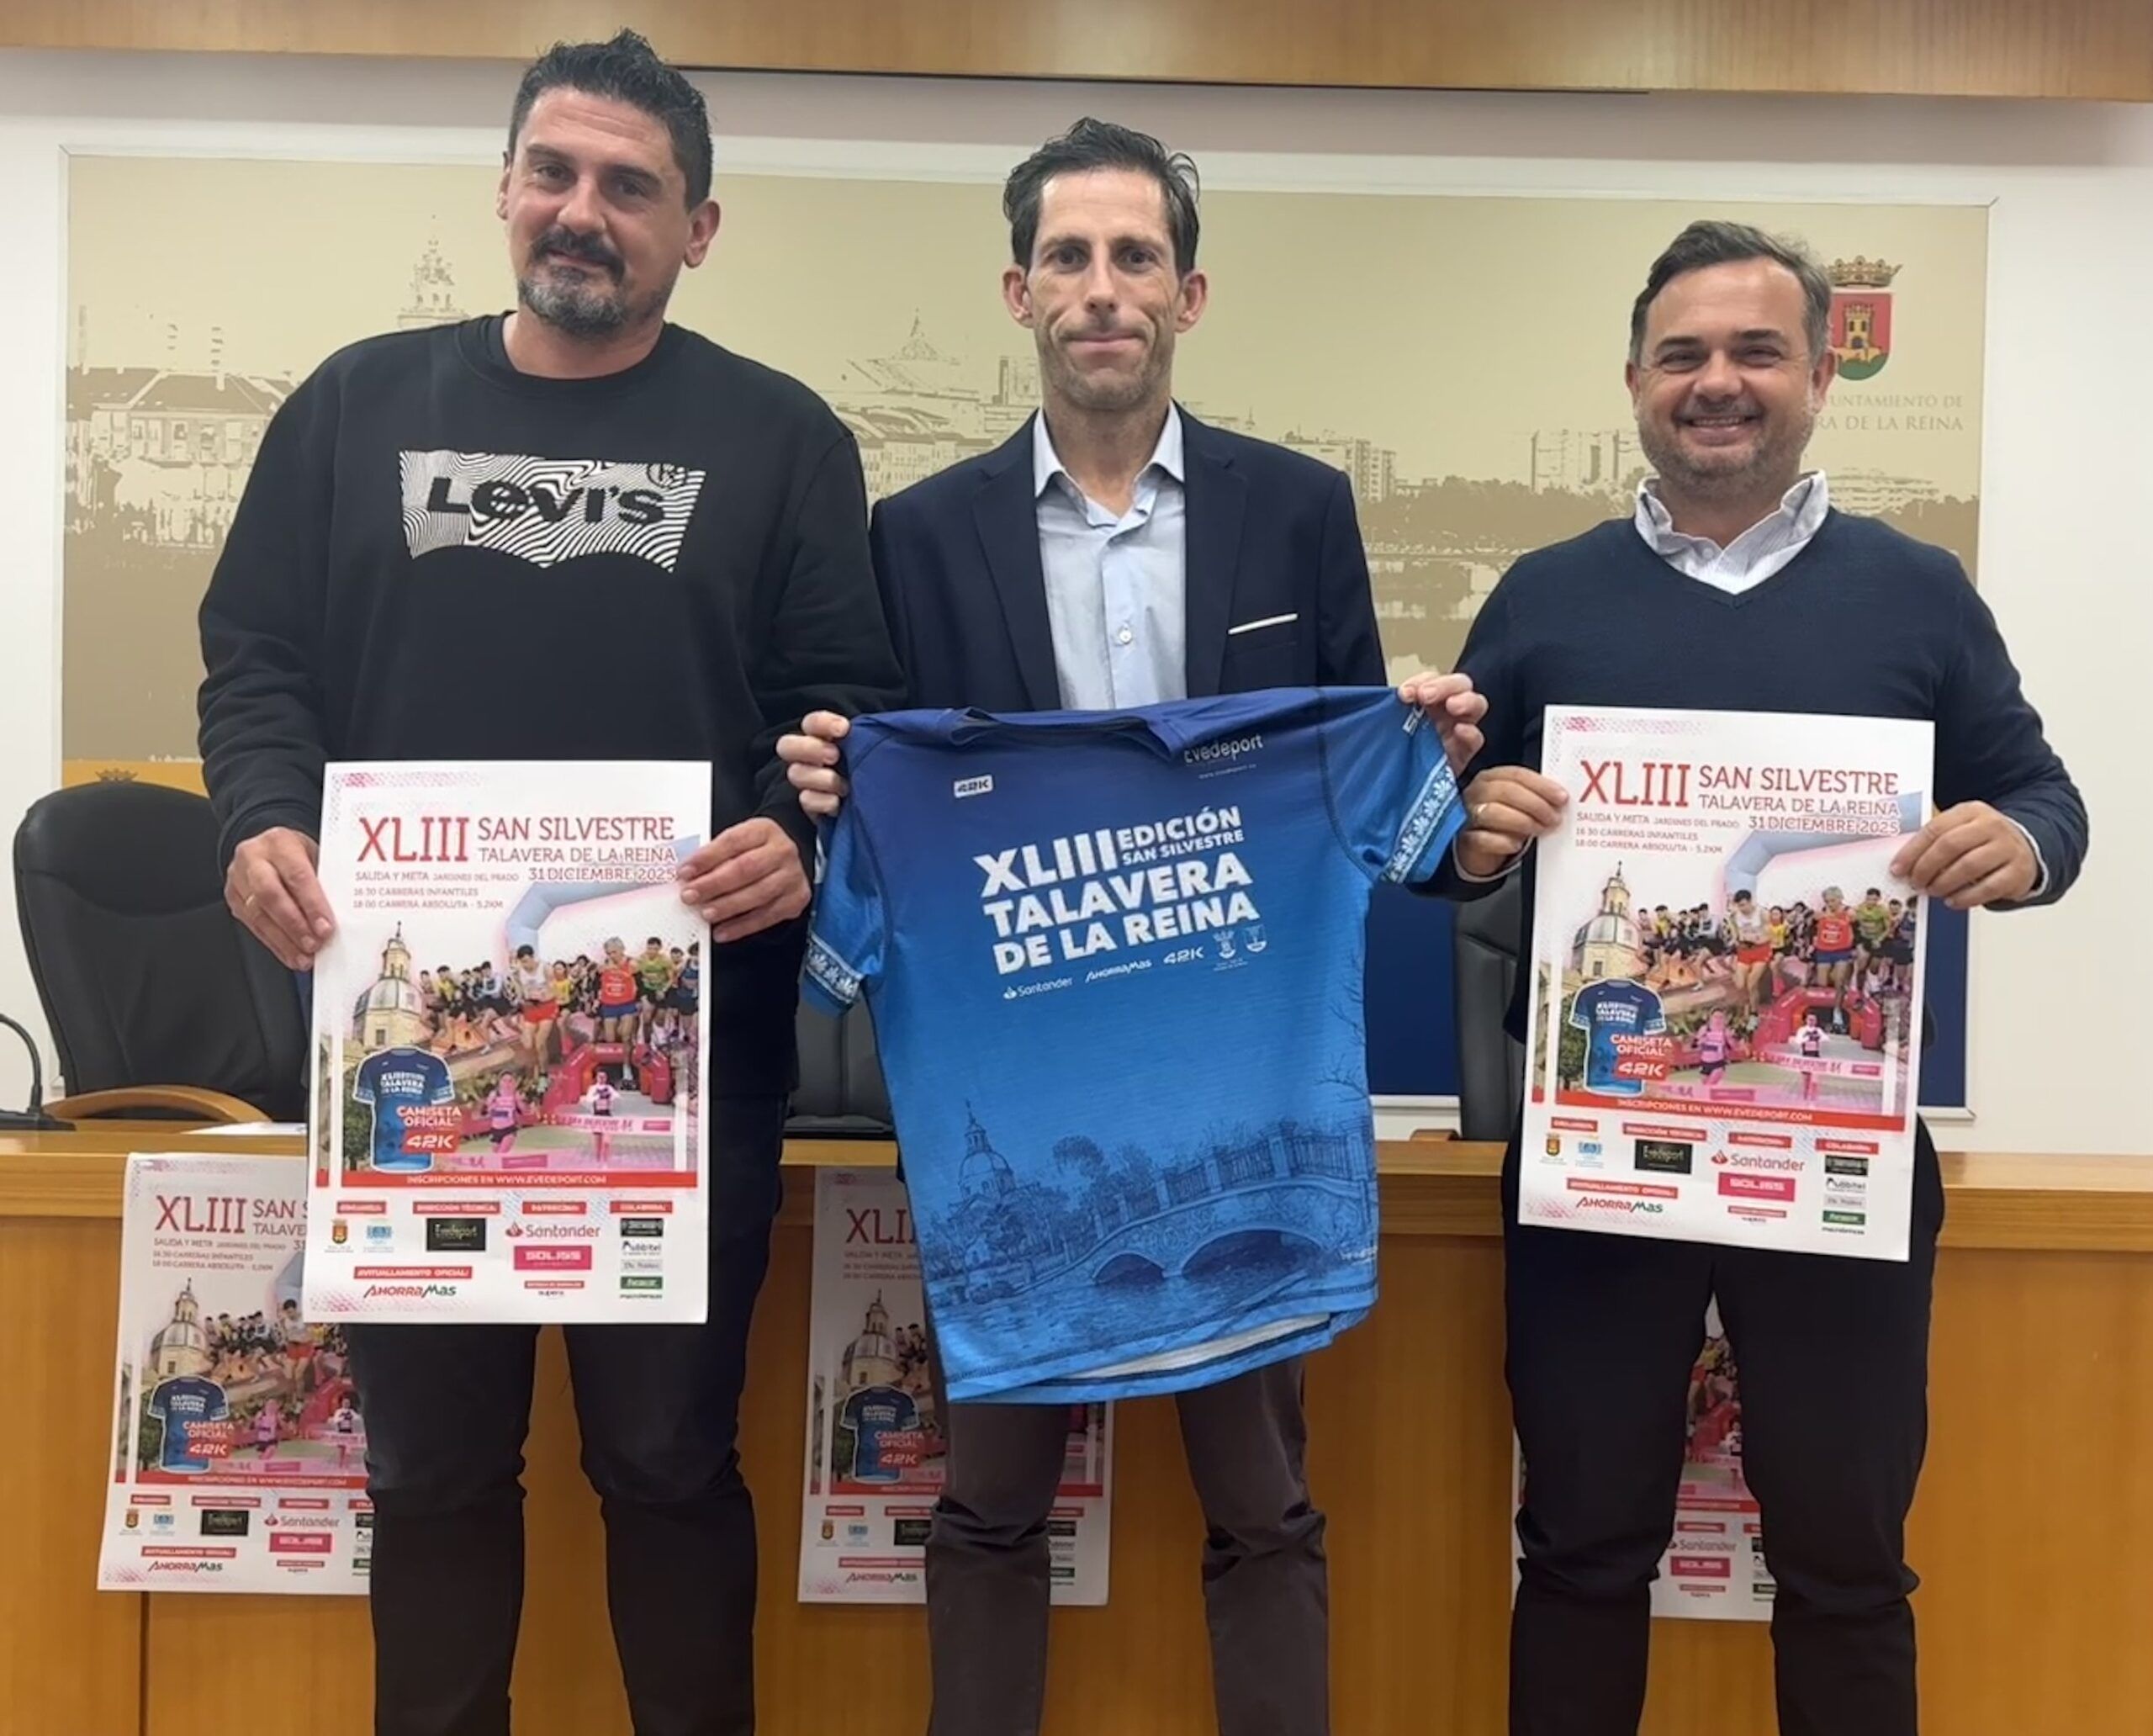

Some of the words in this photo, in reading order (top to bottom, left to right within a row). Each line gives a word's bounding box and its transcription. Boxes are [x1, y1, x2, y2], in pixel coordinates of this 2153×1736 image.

[1830, 394, 1938, 408] UNTAMIENTO
[1944, 394, 1963, 408] DE
[1845, 415, 1868, 430] DE
[1877, 415, 1899, 431] LA
[1906, 416, 1964, 431] REINA
[1579, 760, 1691, 807] XLIII
[1699, 765, 1752, 789] SAN
[1760, 767, 1899, 795] SILVESTRE
[1699, 794, 1786, 812] TALAVERA
[1792, 798, 1814, 812] DE
[1820, 799, 1841, 813] LA
[1847, 801, 1899, 816] REINA
[1577, 812, 1611, 822] SALIDA
[1622, 814, 1649, 824] META
[1860, 820, 1899, 834] 2025
[357, 817, 470, 862] XLIII
[478, 817, 531, 841] SAN
[539, 817, 674, 841] SILVESTRE
[1600, 828, 1644, 839] CARRERAS
[973, 828, 1118, 897] XLIII
[1116, 806, 1242, 851] EDICIÓN
[1121, 850, 1157, 867] SAN
[1161, 829, 1245, 860] SILVESTRE
[1600, 840, 1640, 849] CARRERA
[478, 848, 564, 862] TALAVERA
[570, 848, 593, 862] DE
[598, 848, 618, 862] LA
[624, 848, 676, 862] REINA
[355, 871, 390, 881] SALIDA
[401, 871, 429, 881] META
[983, 852, 1254, 938] TALAVERA
[992, 934, 1052, 975] DE
[1059, 922, 1118, 961] LA
[1123, 891, 1260, 946] REINA
[1018, 977, 1073, 997] Santander
[1610, 1035, 1673, 1048] CAMISETA
[1616, 1044, 1665, 1057] OFICIAL
[1618, 1061, 1665, 1077] 42K
[396, 1106, 462, 1118] CAMISETA
[403, 1117, 454, 1127] OFICIAL
[406, 1135, 452, 1149] 42K
[1731, 1154, 1805, 1171] Santander
[155, 1195, 248, 1233] XLIII
[252, 1199, 294, 1219] SAN
[253, 1223, 307, 1236] TALAVE
[526, 1225, 601, 1238] Santander
[846, 1209, 916, 1244] XLI
[281, 1515, 340, 1527] Santander
[1678, 1540, 1737, 1552] Santander
